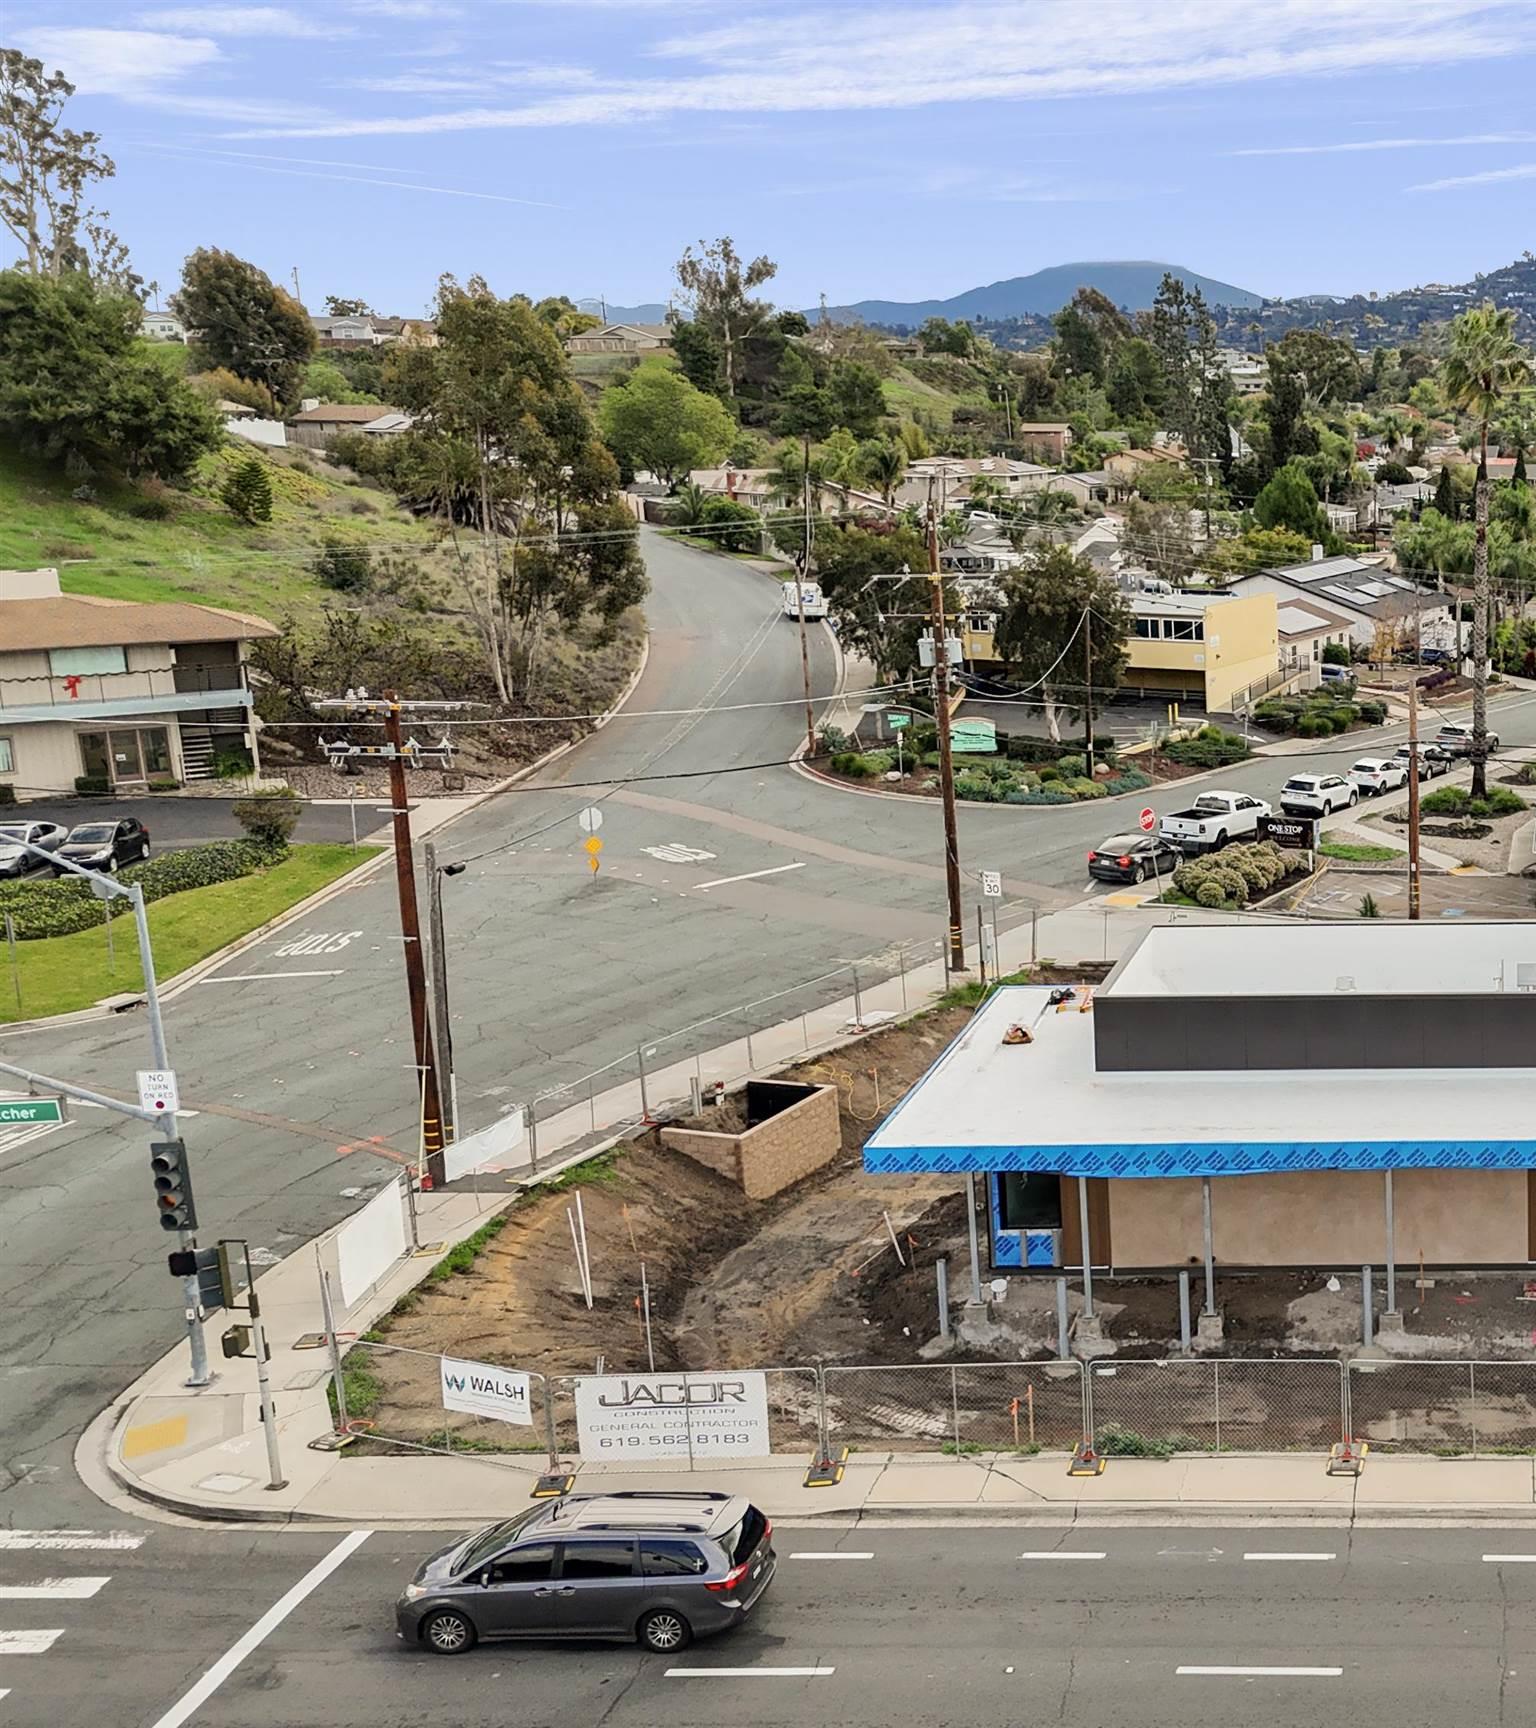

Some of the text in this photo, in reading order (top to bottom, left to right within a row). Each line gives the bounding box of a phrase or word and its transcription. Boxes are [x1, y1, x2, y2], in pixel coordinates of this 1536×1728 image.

[1267, 824, 1303, 833] ONE STOP
[986, 883, 999, 893] 30
[149, 1074, 164, 1082] NO
[0, 1108, 36, 1120] cher
[470, 1376, 524, 1400] WALSH
[598, 1380, 747, 1407] JACOR
[614, 1408, 736, 1418] CONSTRUCTION
[589, 1419, 758, 1433] GENERAL CONTRACTOR
[600, 1433, 749, 1448] 619.562.8183
